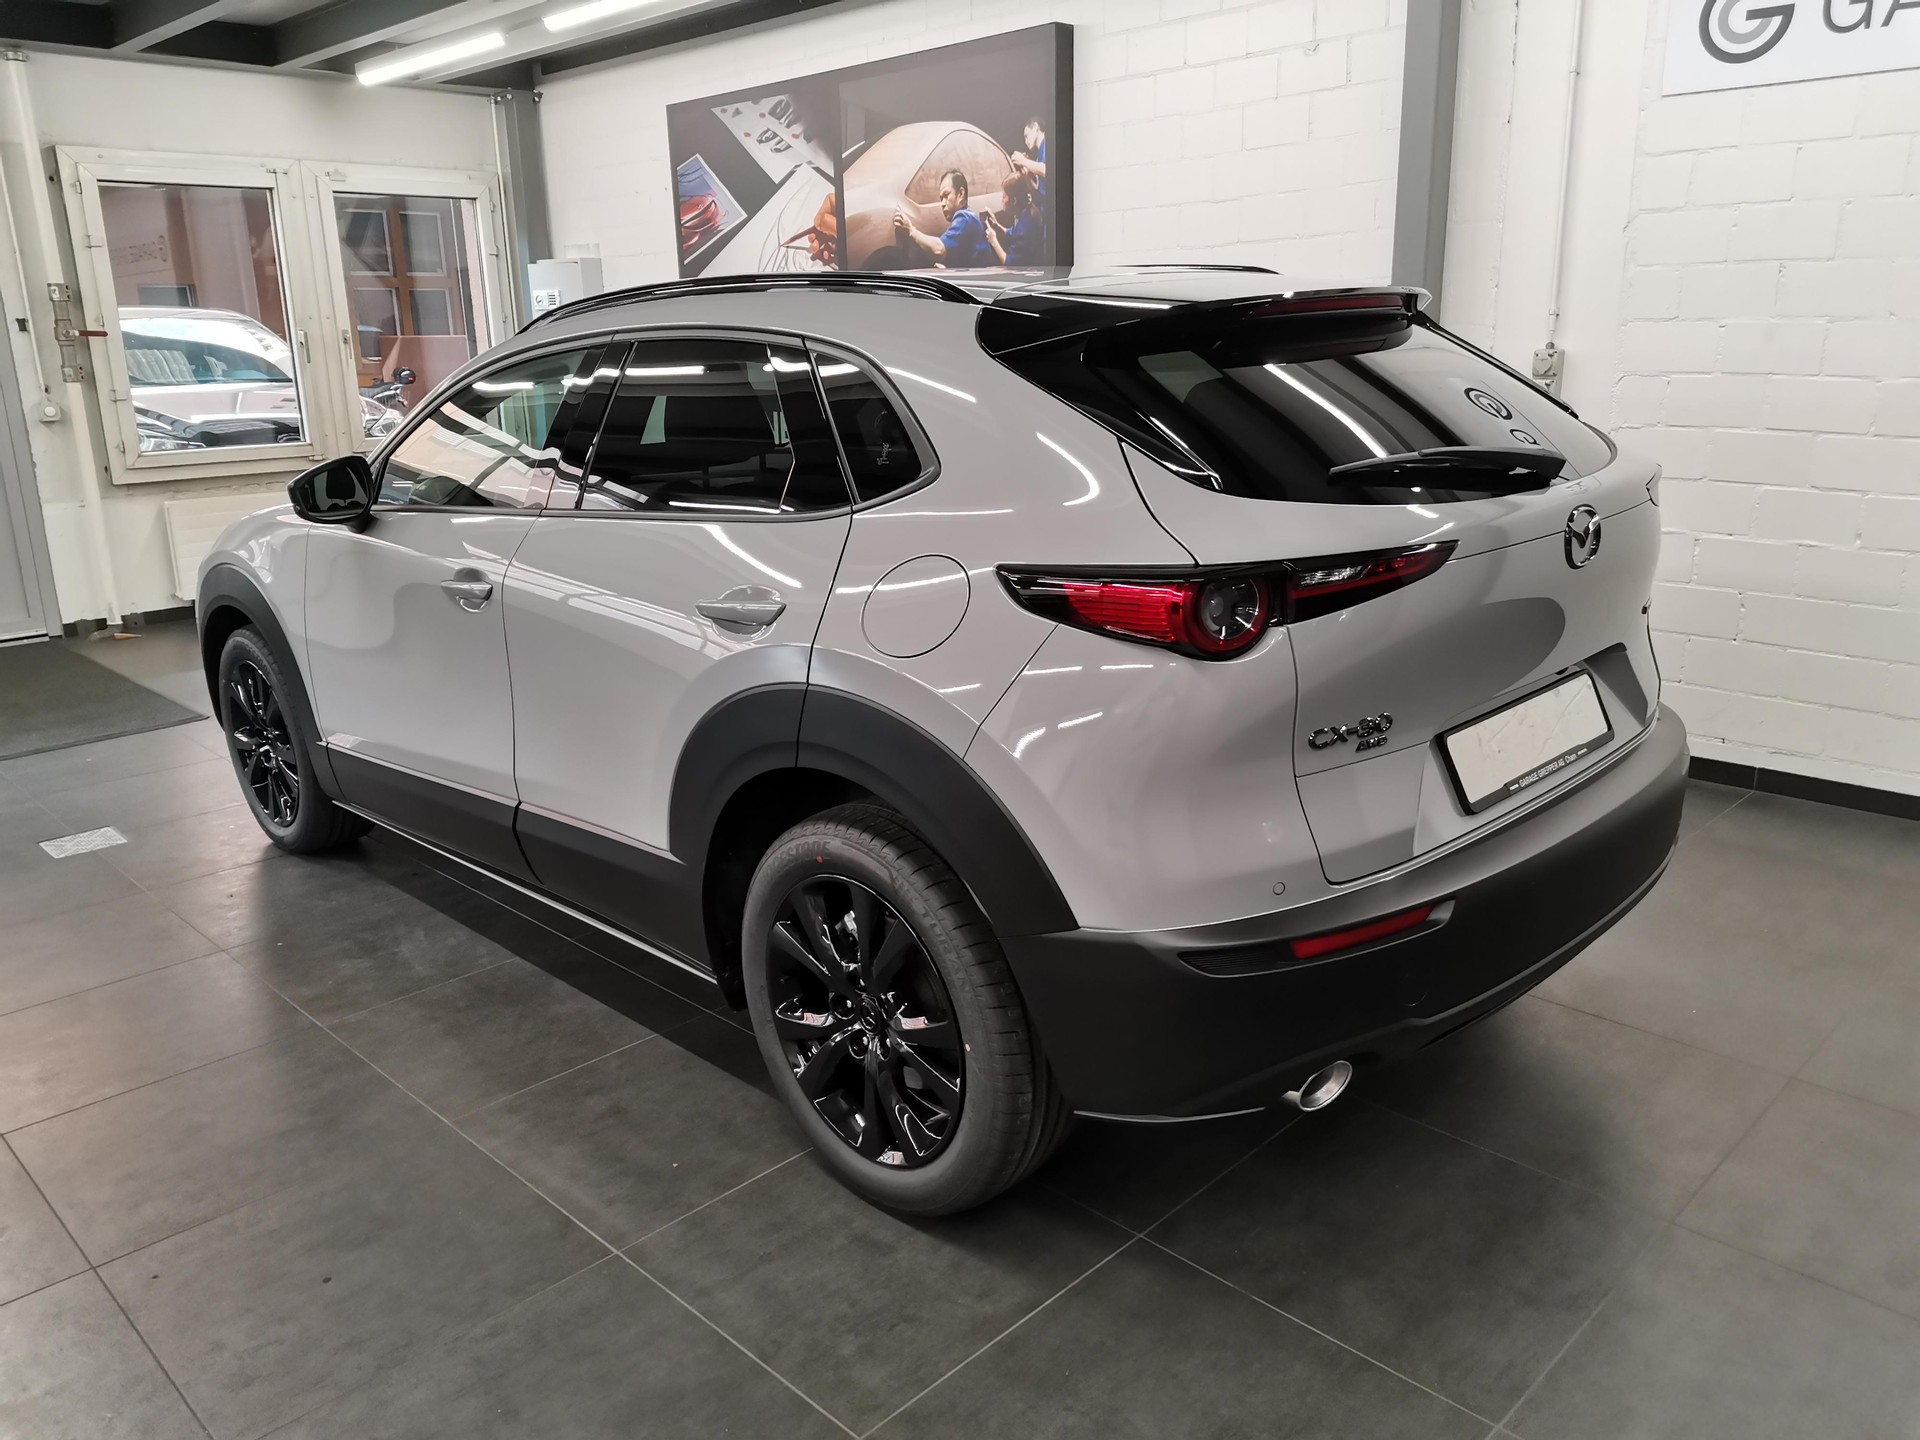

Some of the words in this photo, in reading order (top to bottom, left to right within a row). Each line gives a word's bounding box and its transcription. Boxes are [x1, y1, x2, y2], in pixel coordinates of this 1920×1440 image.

[1308, 712, 1393, 750] CX-30
[1355, 735, 1388, 753] AWD
[1519, 771, 1539, 788] GARAGE
